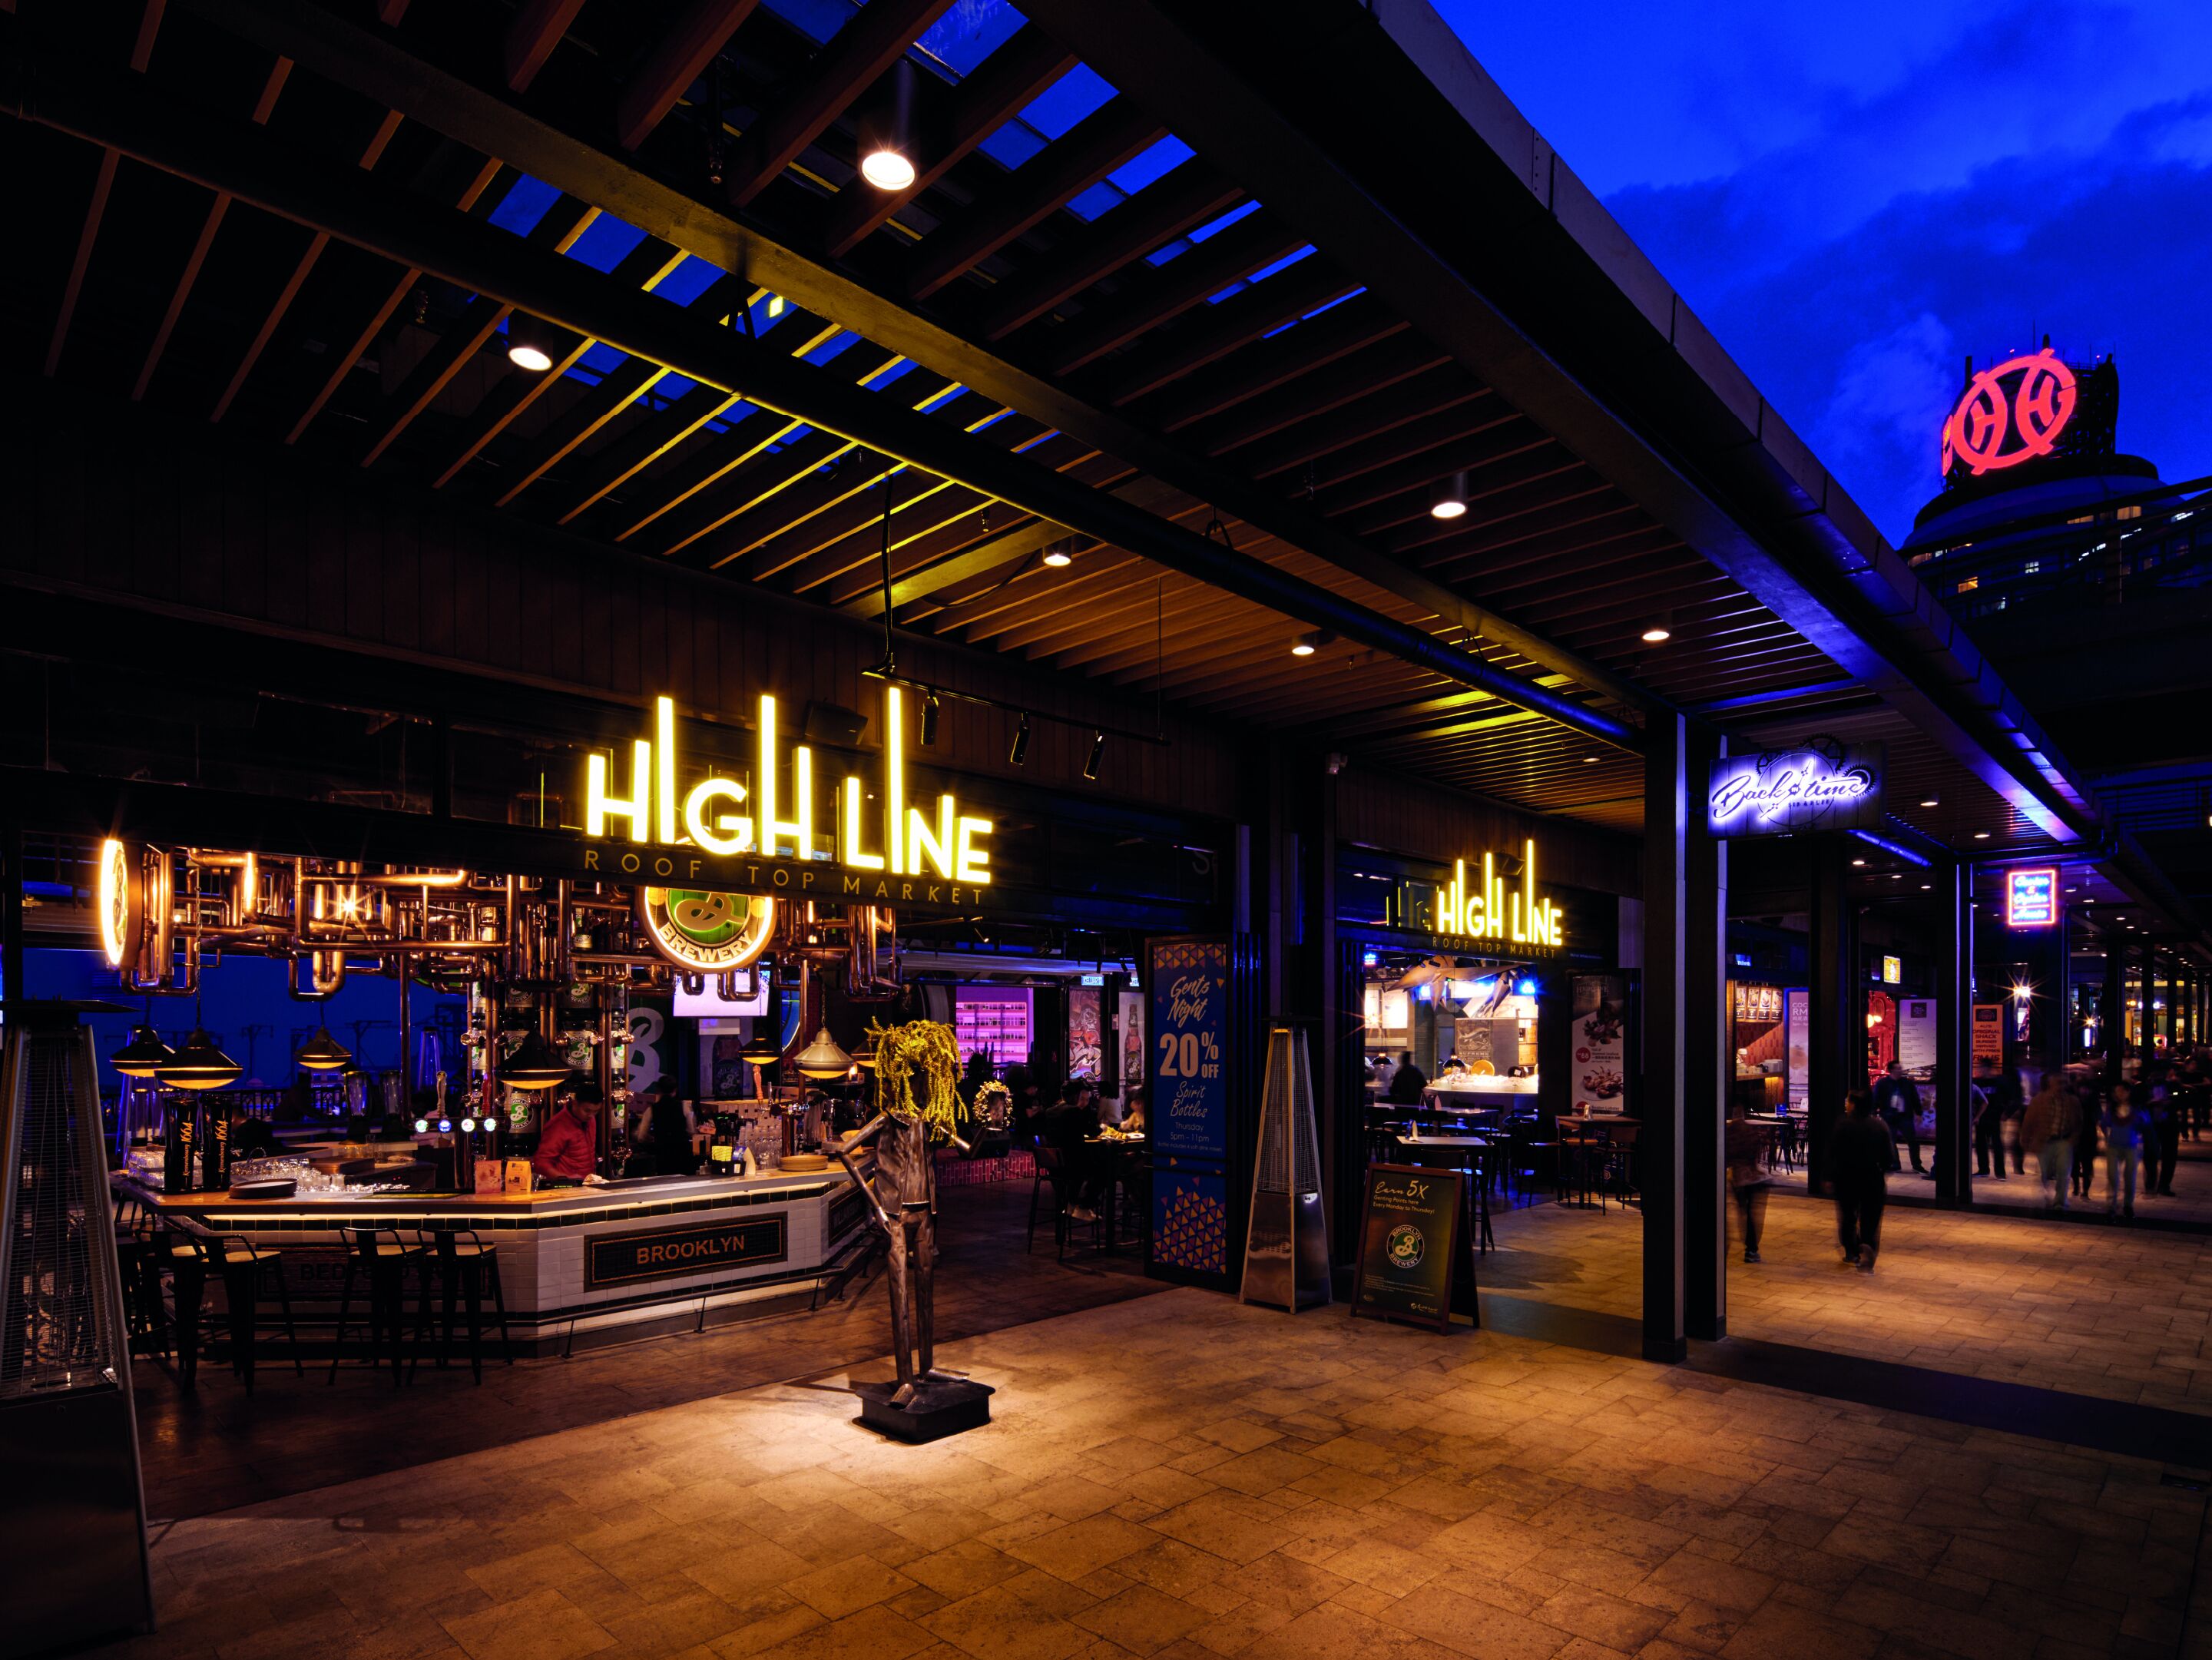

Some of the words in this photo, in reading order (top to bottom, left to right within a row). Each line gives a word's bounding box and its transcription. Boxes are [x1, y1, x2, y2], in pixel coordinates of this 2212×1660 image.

[585, 694, 812, 861] HIGH
[1712, 770, 1793, 819] Back
[1803, 775, 1865, 798] time
[583, 850, 702, 880] ROOF
[747, 865, 815, 890] TOP
[843, 875, 982, 905] MARKET
[1438, 852, 1503, 939] HIGH
[659, 922, 753, 963] BREWERY
[1432, 936, 1469, 951] ROOF
[1479, 942, 1502, 953] TOP
[1510, 945, 1555, 959] MARKET
[1171, 974, 1210, 998] Gents
[1167, 998, 1208, 1028] Night
[1201, 1063, 1220, 1079] OFF
[1176, 1081, 1207, 1105] Spirit
[1171, 1098, 1208, 1118] Bottles
[180, 1121, 194, 1143] 1664
[215, 1119, 229, 1141] 1664
[1174, 1122, 1204, 1132] Thursday
[1170, 1132, 1185, 1141] 5pm
[1191, 1133, 1210, 1145] 11pm
[1373, 1194, 1392, 1203] Genting
[1375, 1181, 1404, 1194] Earn
[1373, 1201, 1386, 1209] Every
[1386, 1203, 1404, 1211] Monday
[1392, 1226, 1422, 1241] BROOKLYN
[636, 1234, 745, 1265] BROOKLYN
[1389, 1253, 1419, 1267] BREWERY
